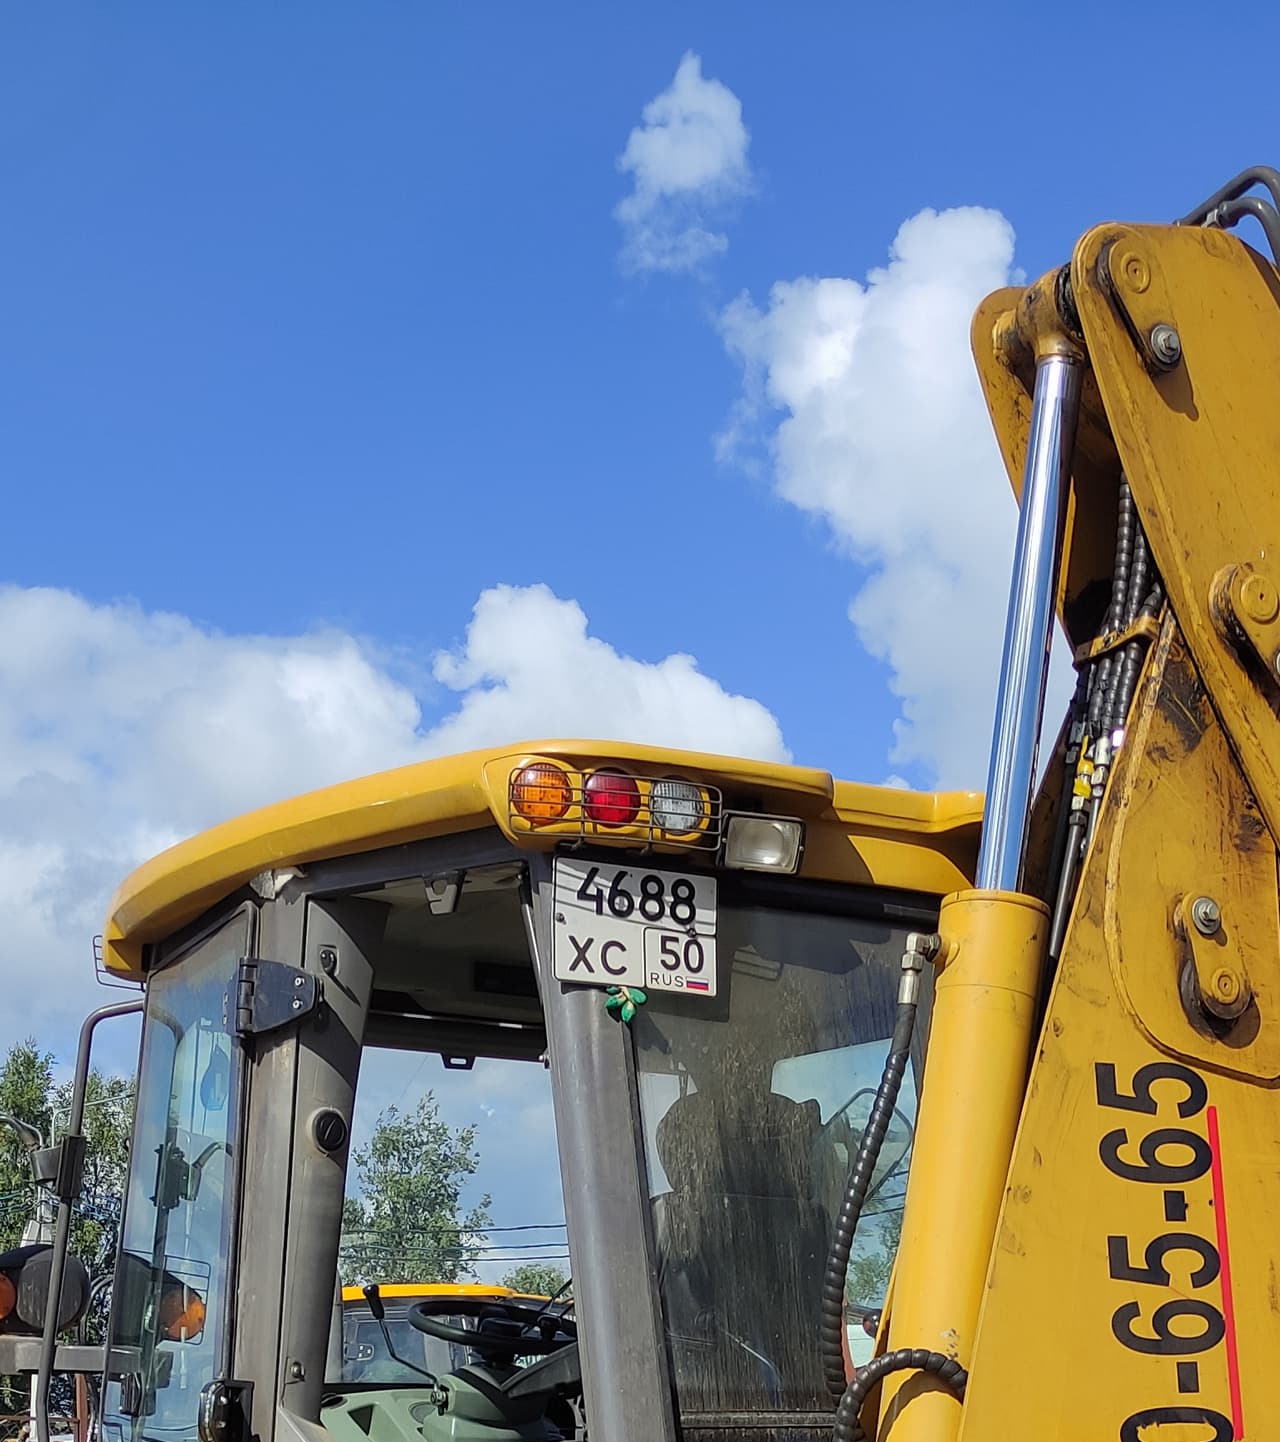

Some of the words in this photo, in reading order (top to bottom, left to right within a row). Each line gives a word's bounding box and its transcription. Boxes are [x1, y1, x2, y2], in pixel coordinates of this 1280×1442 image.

[576, 866, 696, 926] 4688
[660, 935, 705, 974] 50
[650, 972, 684, 988] RUS
